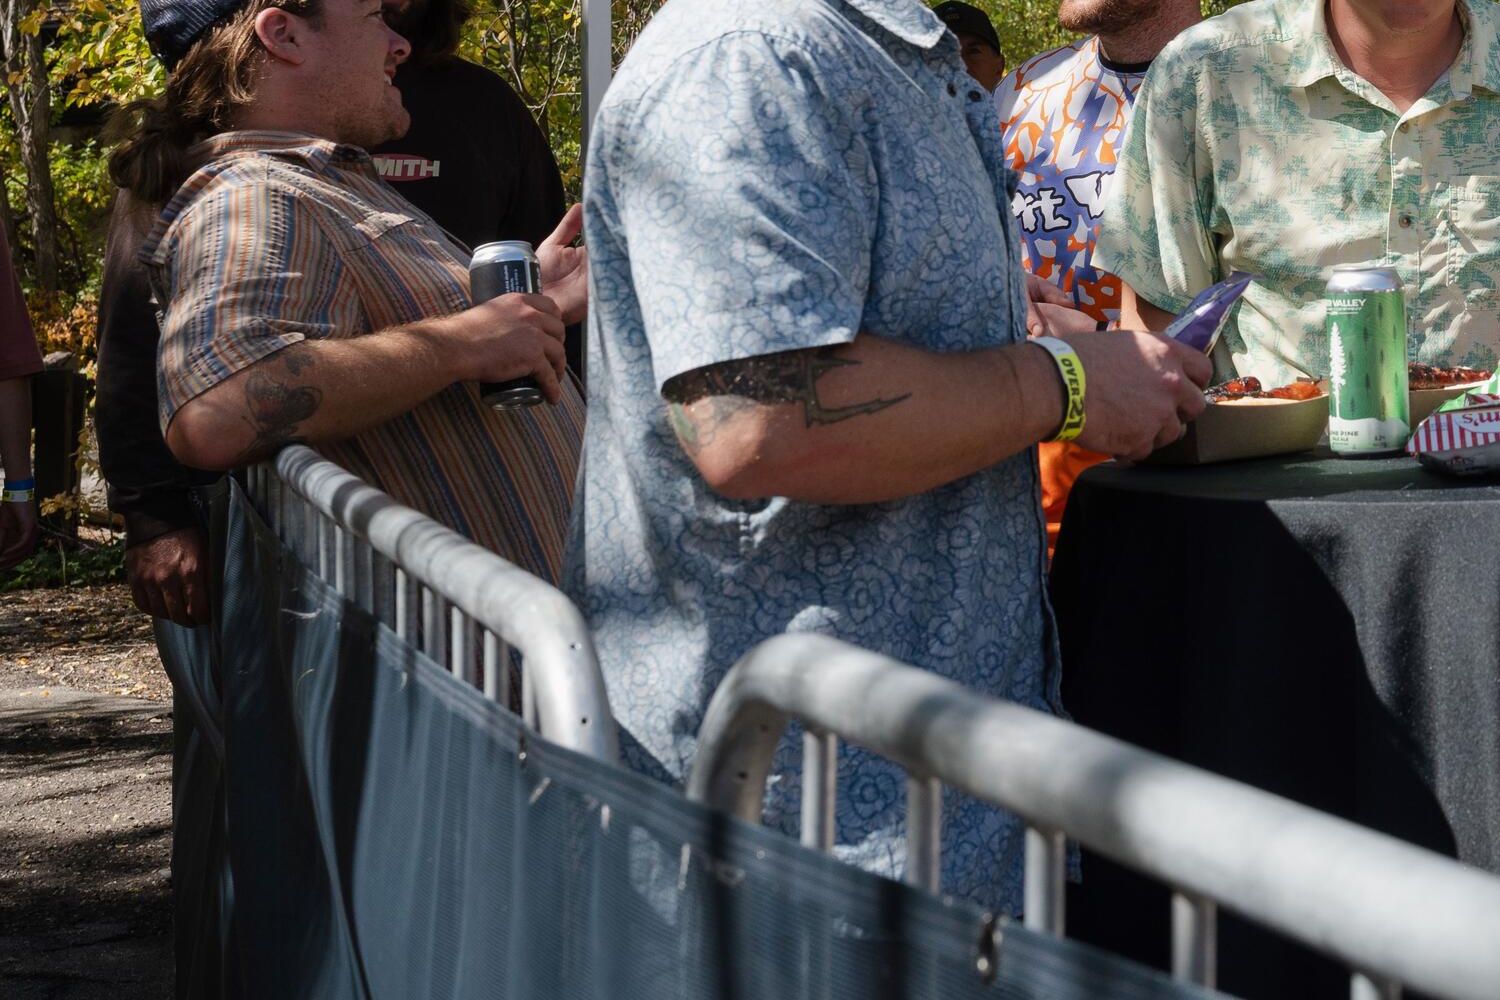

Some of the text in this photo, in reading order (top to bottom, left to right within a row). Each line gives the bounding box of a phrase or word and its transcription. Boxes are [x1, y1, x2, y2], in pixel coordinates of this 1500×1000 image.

[372, 157, 440, 177] MITH
[1333, 299, 1367, 307] VALLEY
[1061, 358, 1080, 396] OVER
